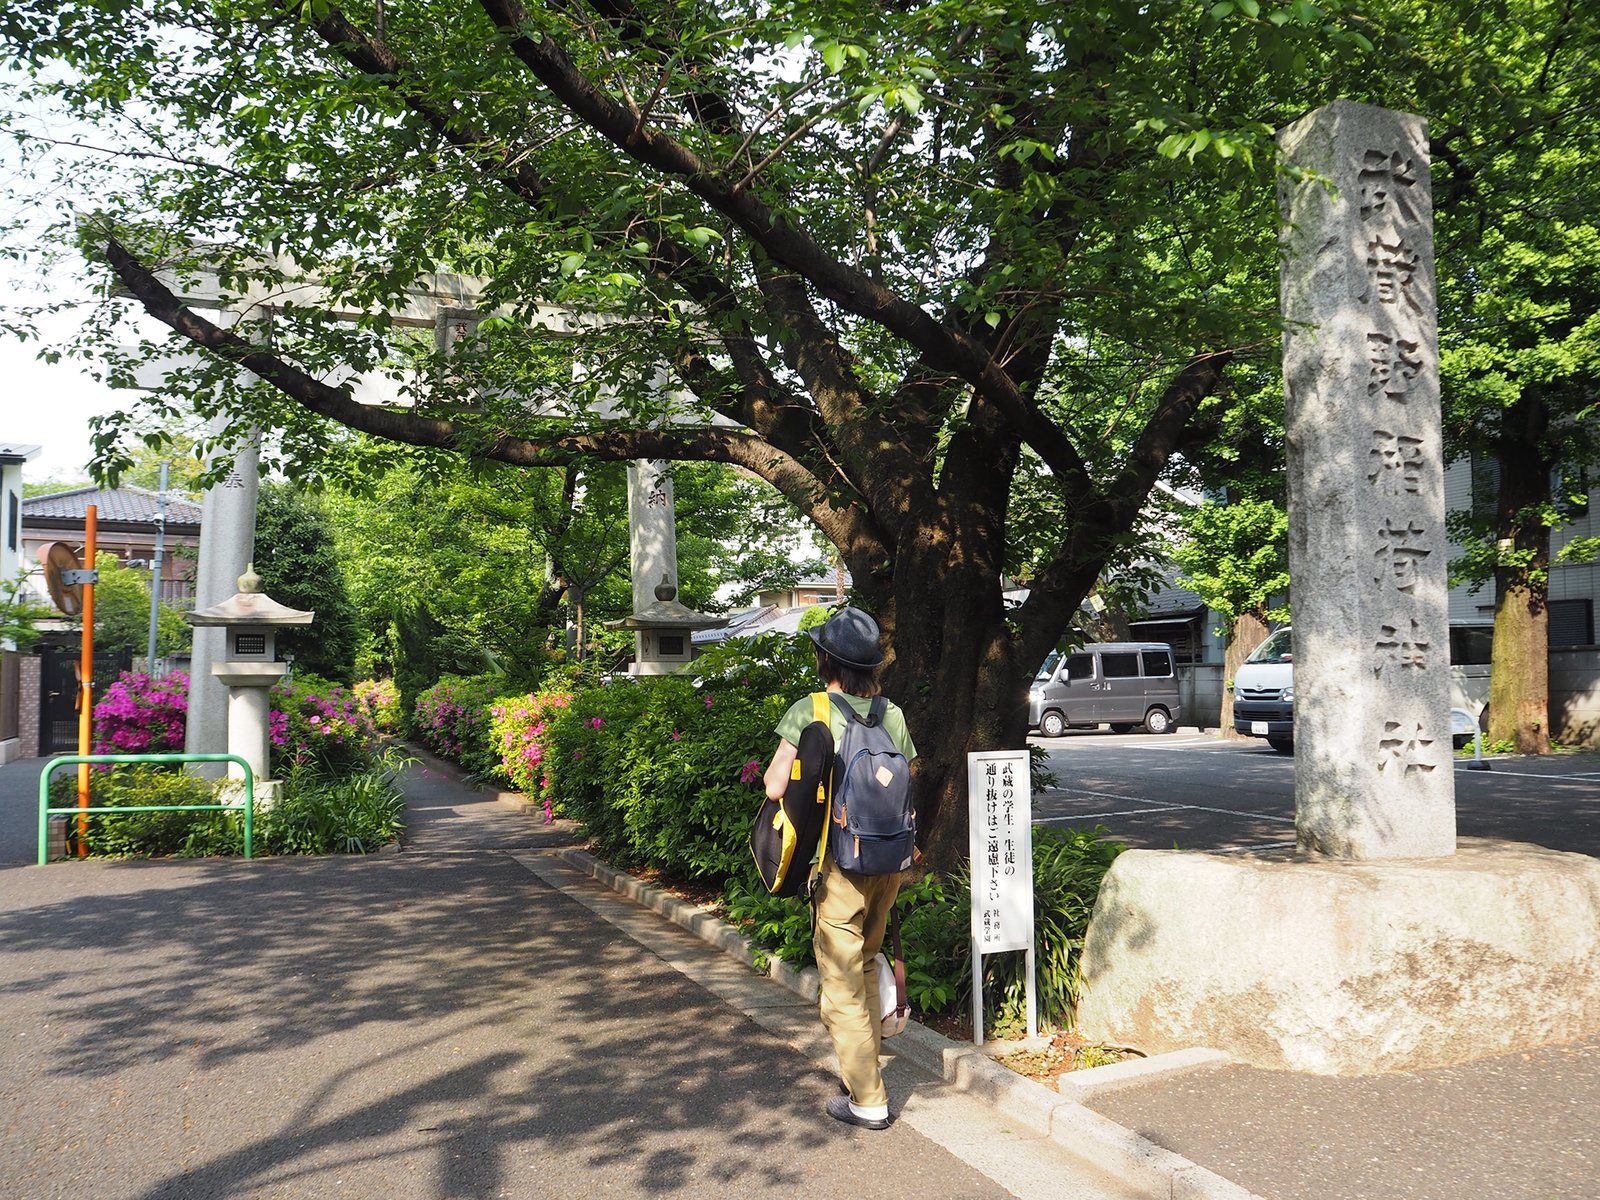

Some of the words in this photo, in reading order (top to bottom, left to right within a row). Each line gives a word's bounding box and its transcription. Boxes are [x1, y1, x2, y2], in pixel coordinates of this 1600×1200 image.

[222, 469, 245, 491] 奉
[648, 489, 666, 509] 納
[1358, 149, 1437, 776] 武蔵野稲荷神社
[986, 762, 999, 901] 通り抜けはご遠慮下さい
[1002, 762, 1016, 876] 武蔵の学生・生徒の
